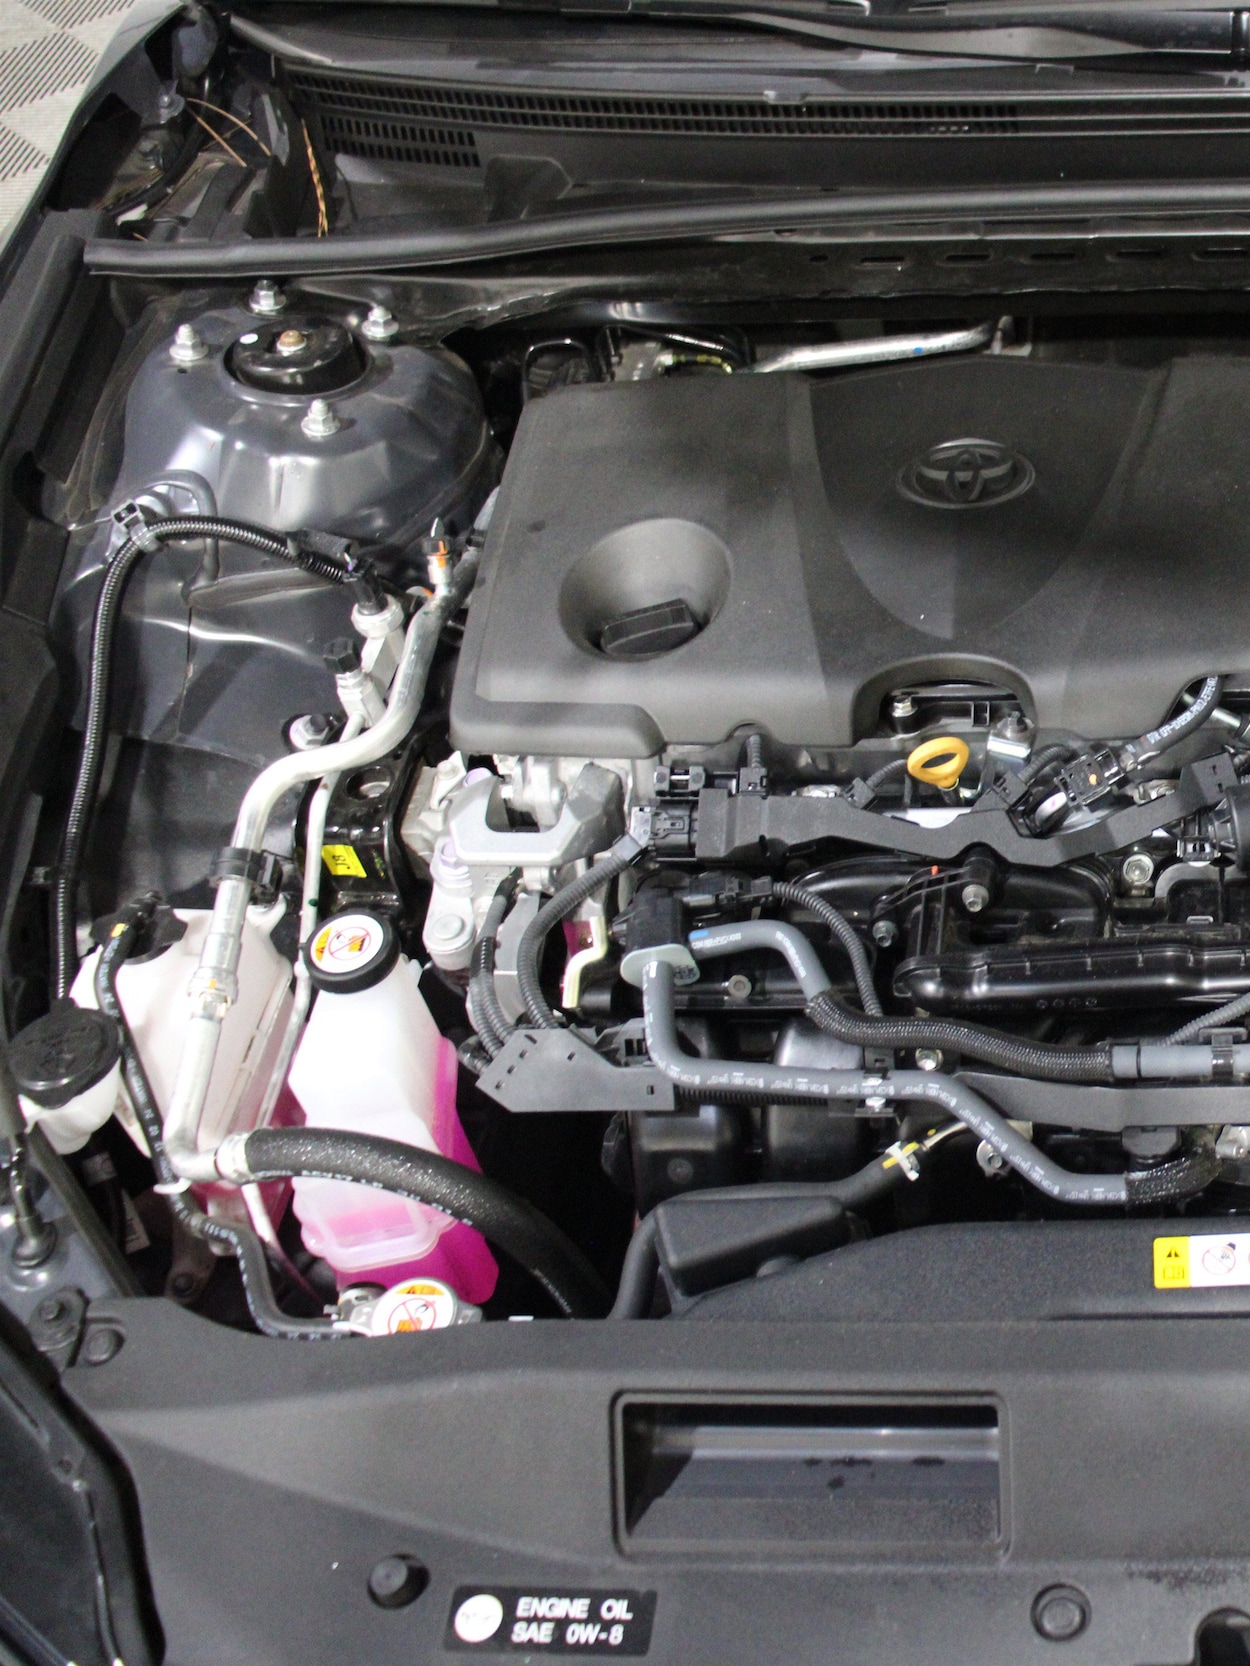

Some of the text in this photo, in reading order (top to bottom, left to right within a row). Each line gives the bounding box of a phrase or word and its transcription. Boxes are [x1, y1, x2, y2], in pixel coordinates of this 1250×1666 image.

[515, 1596, 634, 1621] ENGINE OIL
[510, 1621, 625, 1646] SAE 0W-8
